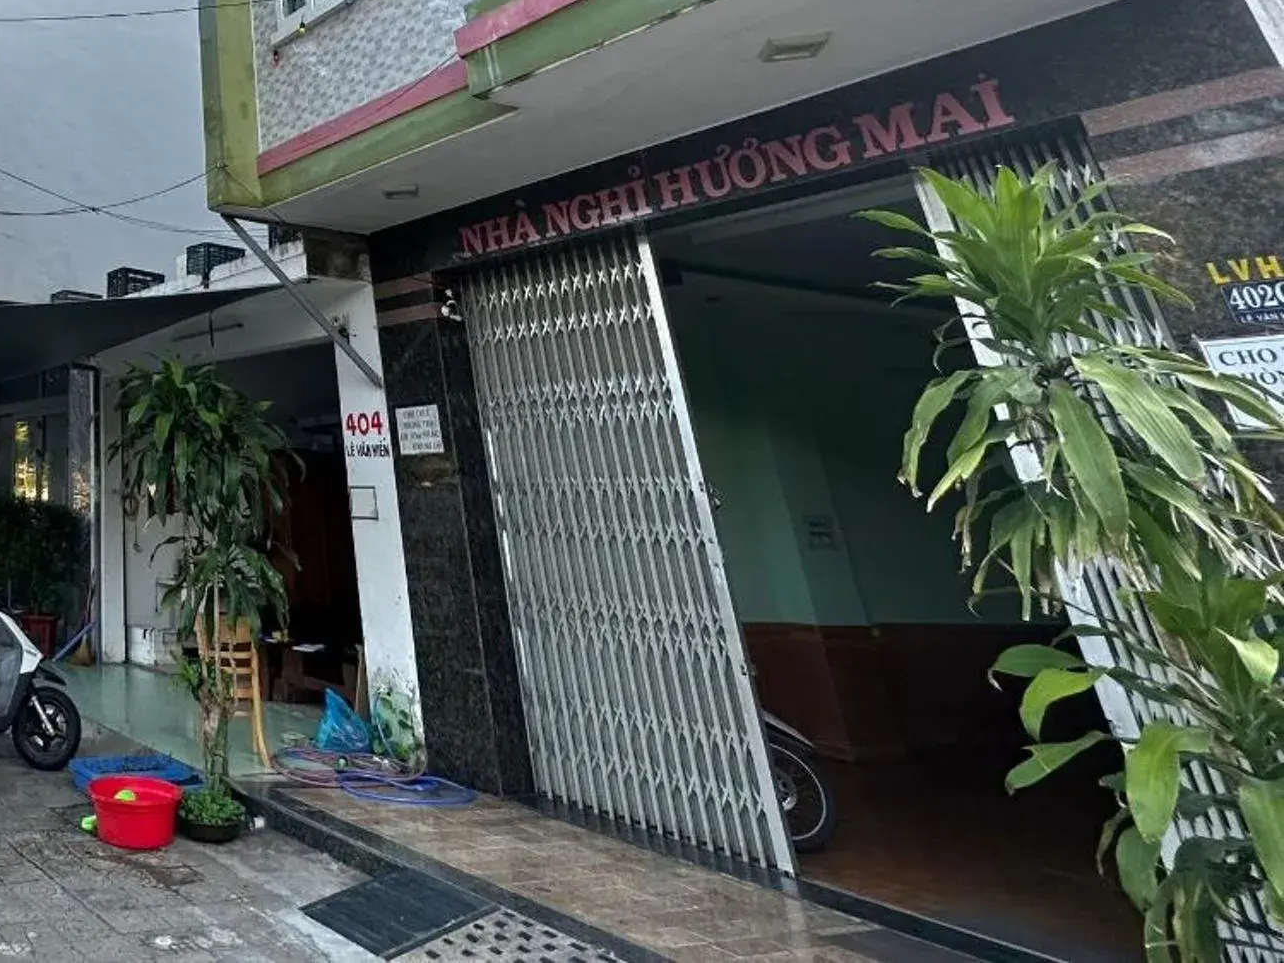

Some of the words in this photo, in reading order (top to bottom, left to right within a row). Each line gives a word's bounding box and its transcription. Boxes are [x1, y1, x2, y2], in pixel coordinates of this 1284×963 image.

[458, 199, 542, 259] NHÀ
[541, 165, 653, 238] NGHỈ
[1218, 347, 1279, 367] CHO
[346, 411, 383, 436] 404
